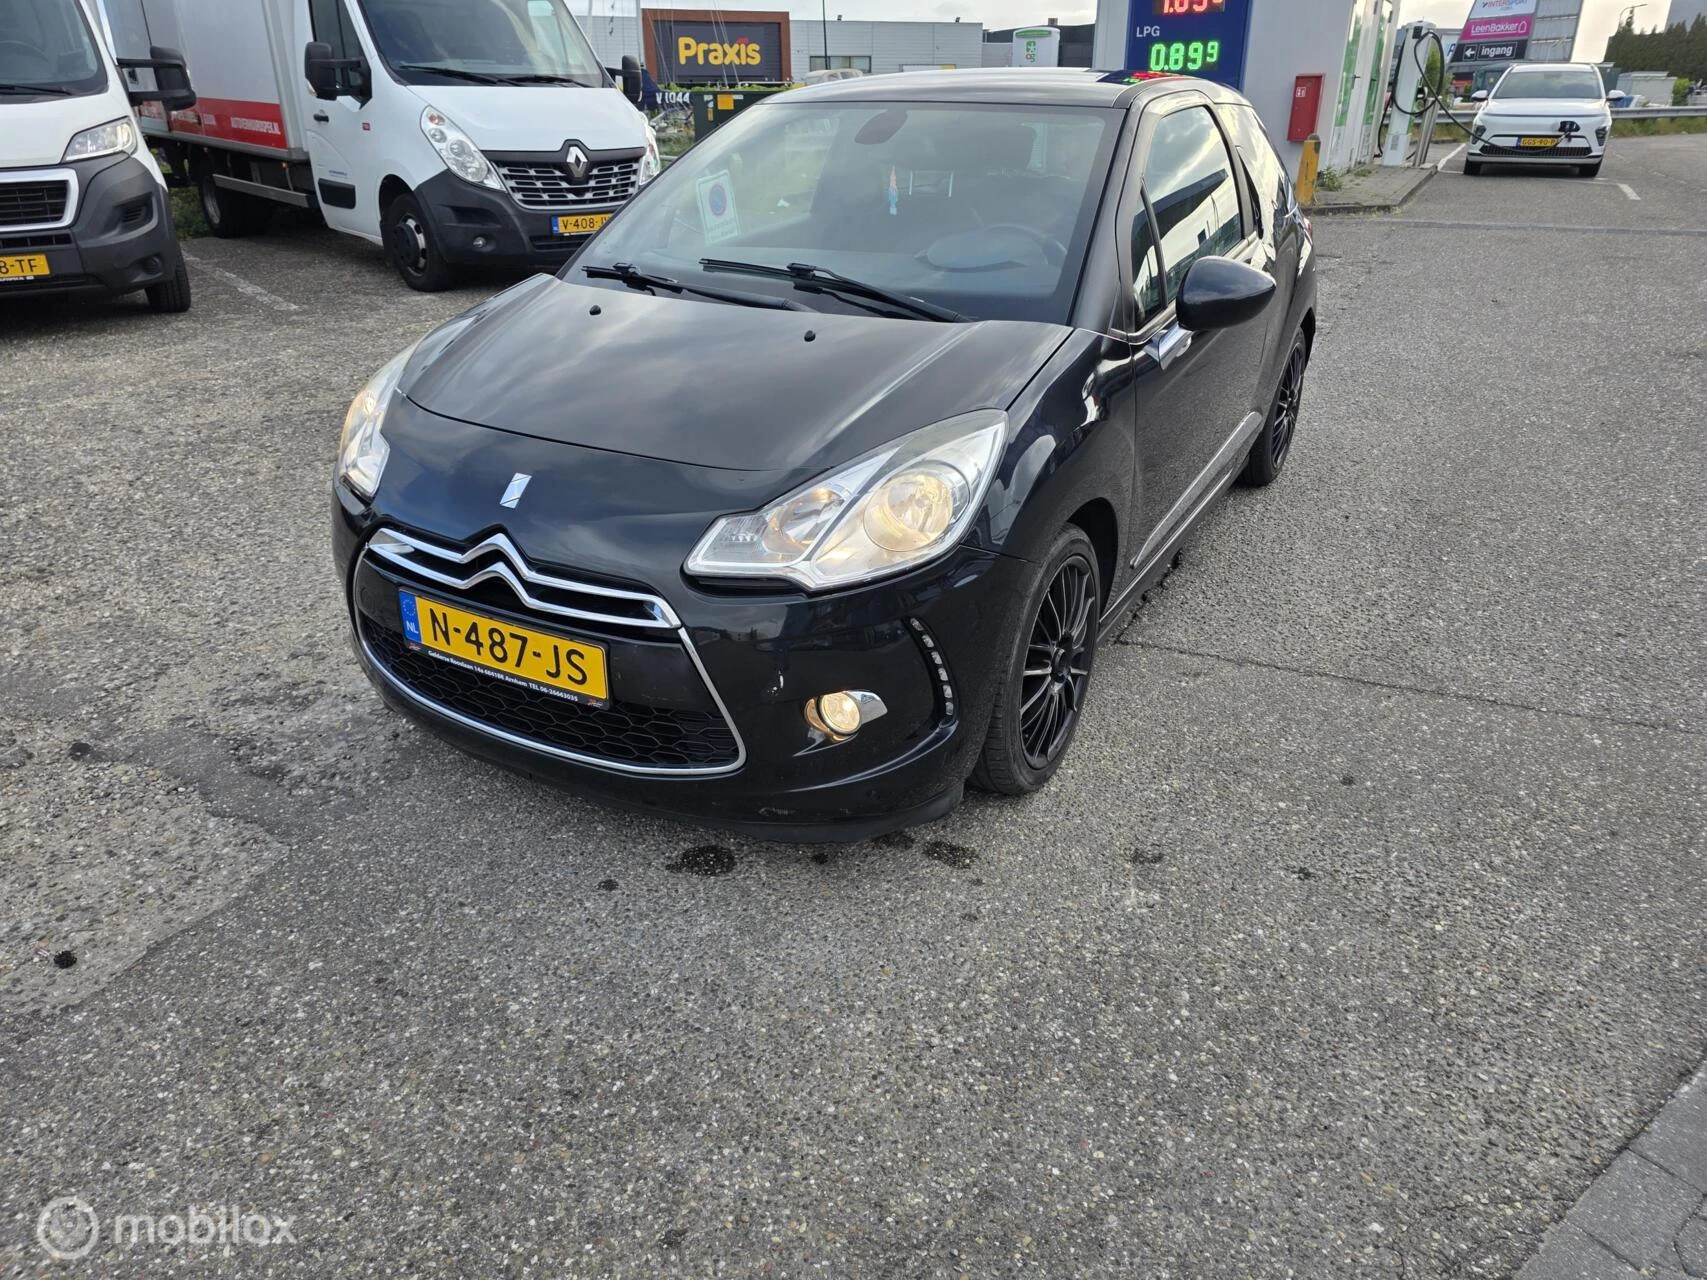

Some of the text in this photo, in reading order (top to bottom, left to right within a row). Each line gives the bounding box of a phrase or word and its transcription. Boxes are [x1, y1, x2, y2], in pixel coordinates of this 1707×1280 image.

[1136, 26, 1160, 37] LPG
[1471, 22, 1518, 34] LeenBakker
[678, 36, 761, 65] Praxis
[1481, 45, 1513, 57] ingang
[406, 620, 419, 635] NL
[429, 608, 588, 686] N-487-JS
[528, 682, 540, 691] TEL
